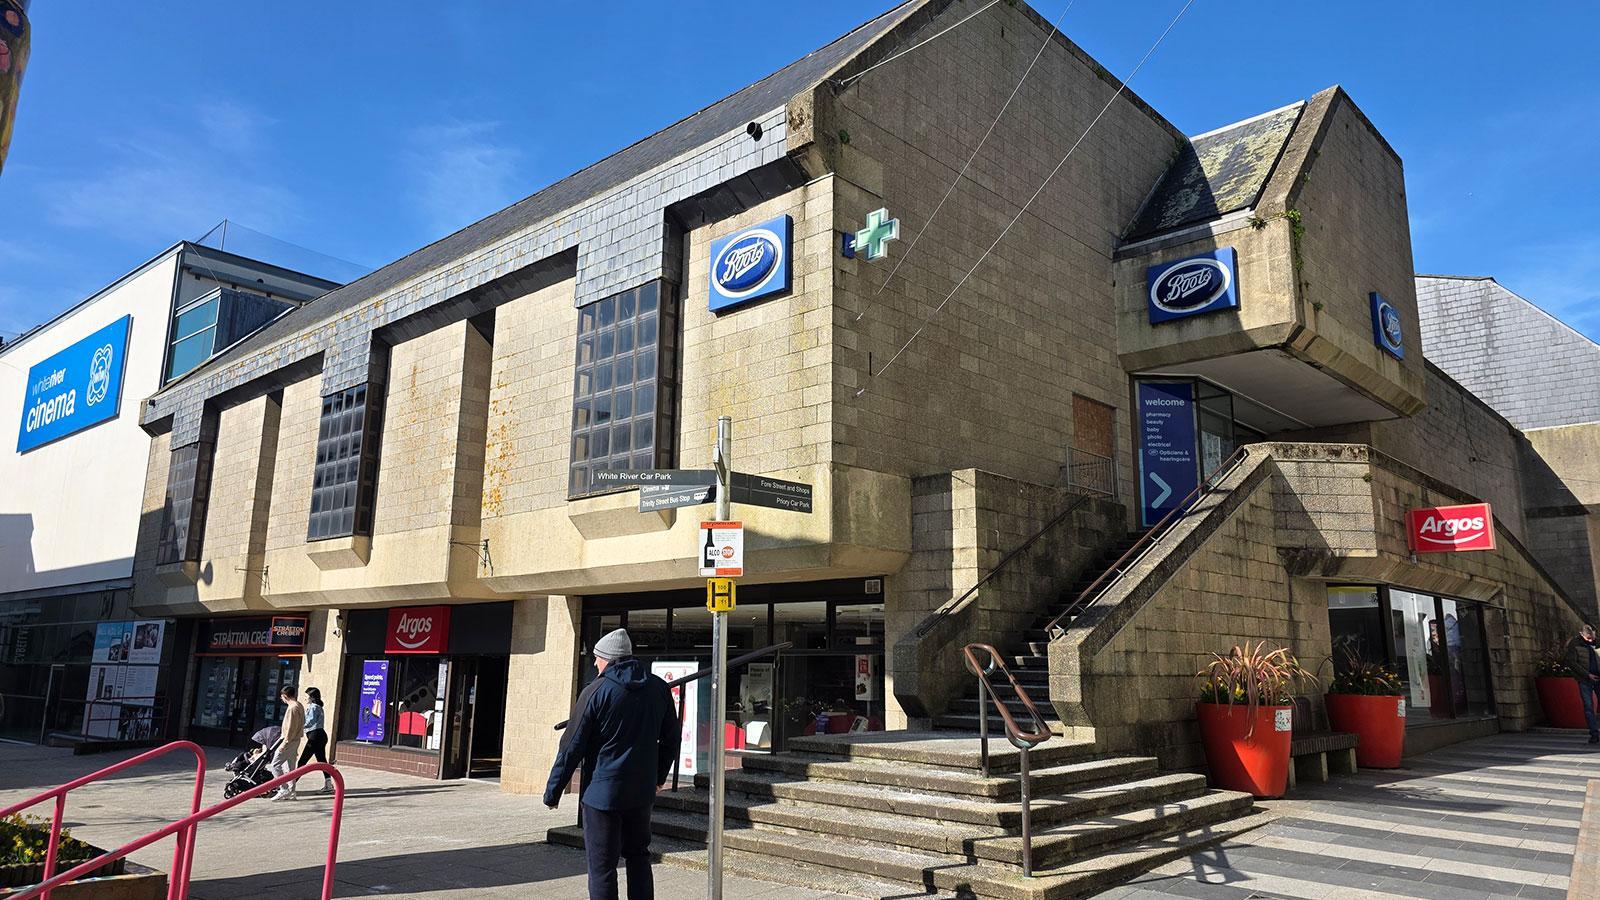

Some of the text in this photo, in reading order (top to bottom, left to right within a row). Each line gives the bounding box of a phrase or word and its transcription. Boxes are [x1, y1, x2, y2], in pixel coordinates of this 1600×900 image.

[720, 237, 765, 285] Boots
[1163, 267, 1213, 302] Boots
[32, 368, 67, 396] whiteriver
[1145, 398, 1185, 406] welcome
[26, 389, 77, 433] cinema
[598, 472, 672, 480] White River Car Park
[761, 480, 810, 495] Fore Street and Shops
[642, 495, 691, 508] Trinity Street Bus Stop
[777, 497, 810, 509] Priory Car Park
[1420, 516, 1485, 537] Argos
[709, 549, 720, 557] ALCO
[272, 625, 304, 633] STRATTON
[397, 613, 432, 639] Argos
[213, 629, 250, 646] STRATTON
